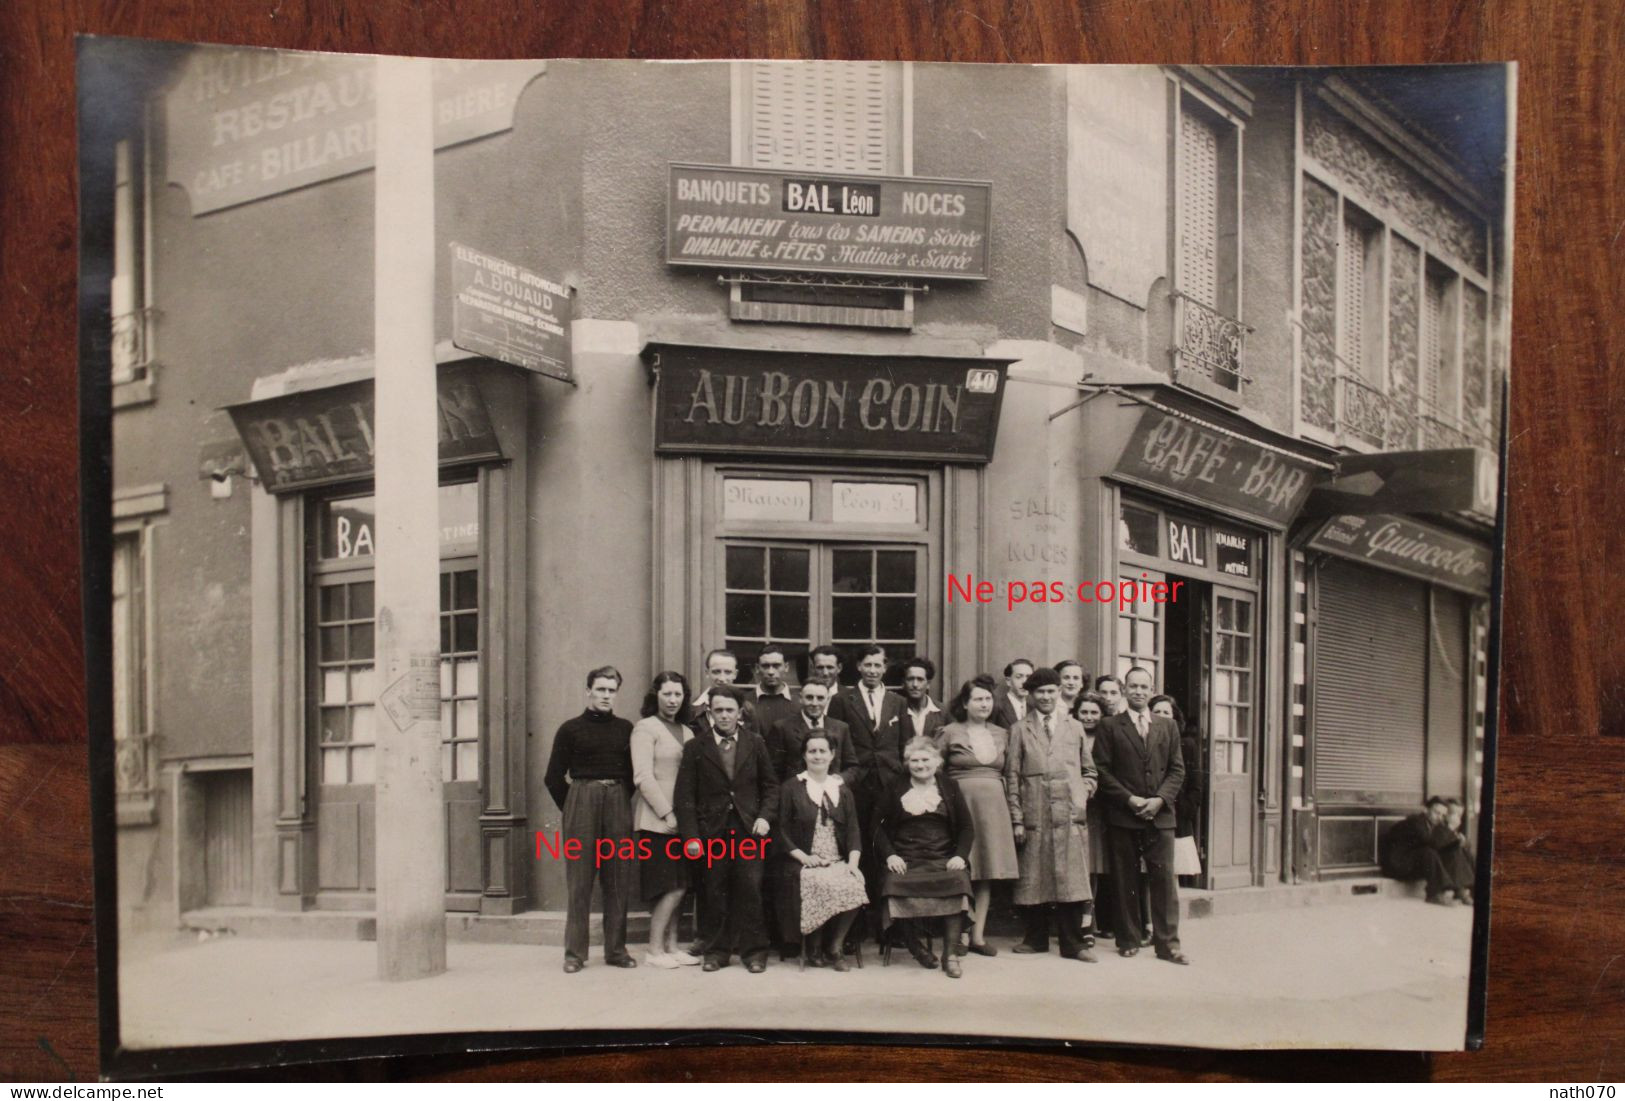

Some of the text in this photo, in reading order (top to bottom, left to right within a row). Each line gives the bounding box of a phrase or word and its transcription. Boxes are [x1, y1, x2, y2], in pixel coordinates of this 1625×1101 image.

[677, 178, 966, 217] BANQUETS BAL Léon NOCES
[676, 214, 983, 248] PERMANENT tous les SAMEDIS Soirée
[682, 237, 974, 270] DIMANCHE & FÊTES Matinée & Soirée
[683, 368, 963, 434] AU BON COIN
[969, 371, 996, 392] 40
[256, 412, 360, 472] BAL
[1143, 415, 1309, 510] CAFÉ BAR
[1169, 520, 1204, 566] BAL
